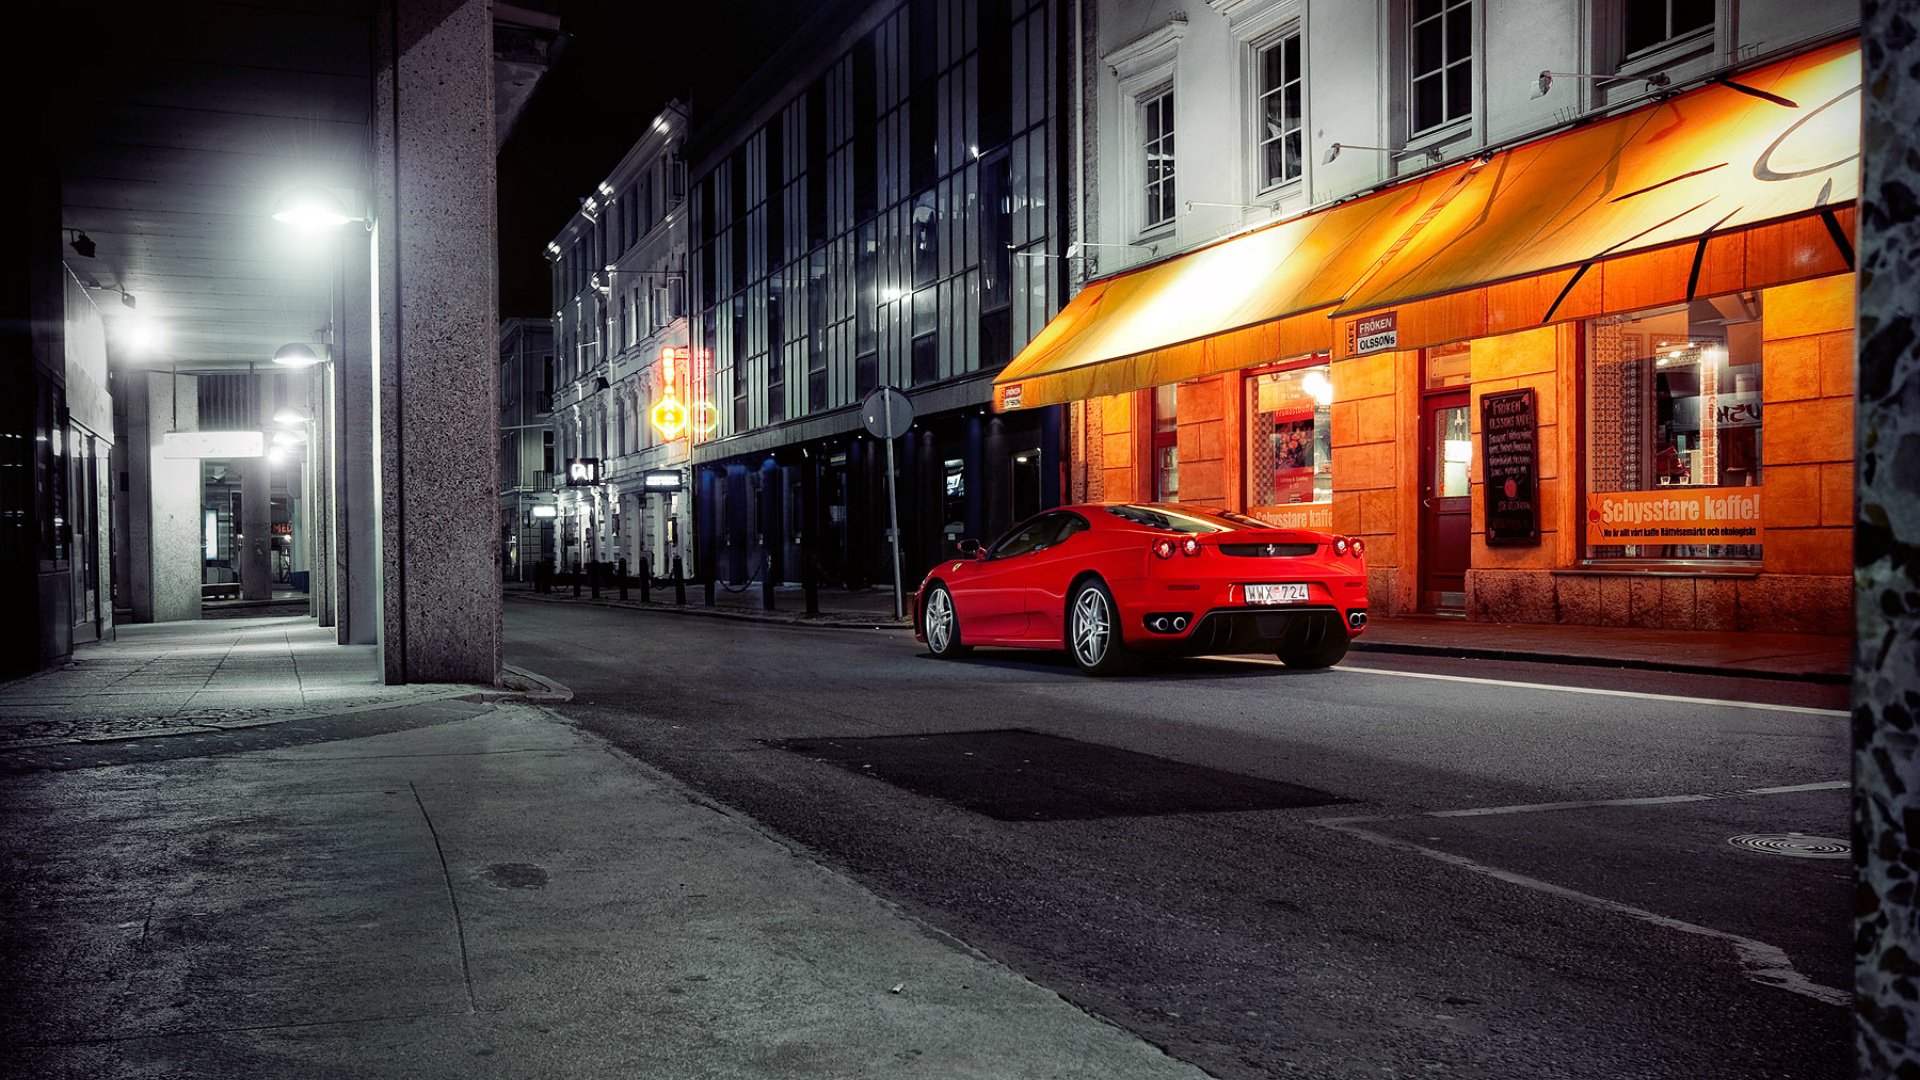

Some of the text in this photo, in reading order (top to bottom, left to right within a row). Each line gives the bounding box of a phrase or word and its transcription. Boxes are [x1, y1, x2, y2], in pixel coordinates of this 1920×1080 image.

[1359, 317, 1392, 334] FRÖKEN
[1359, 335, 1395, 350] OLSSONs
[1602, 494, 1760, 524] Schysstare kaffe!
[1248, 585, 1306, 600] WWX 724
